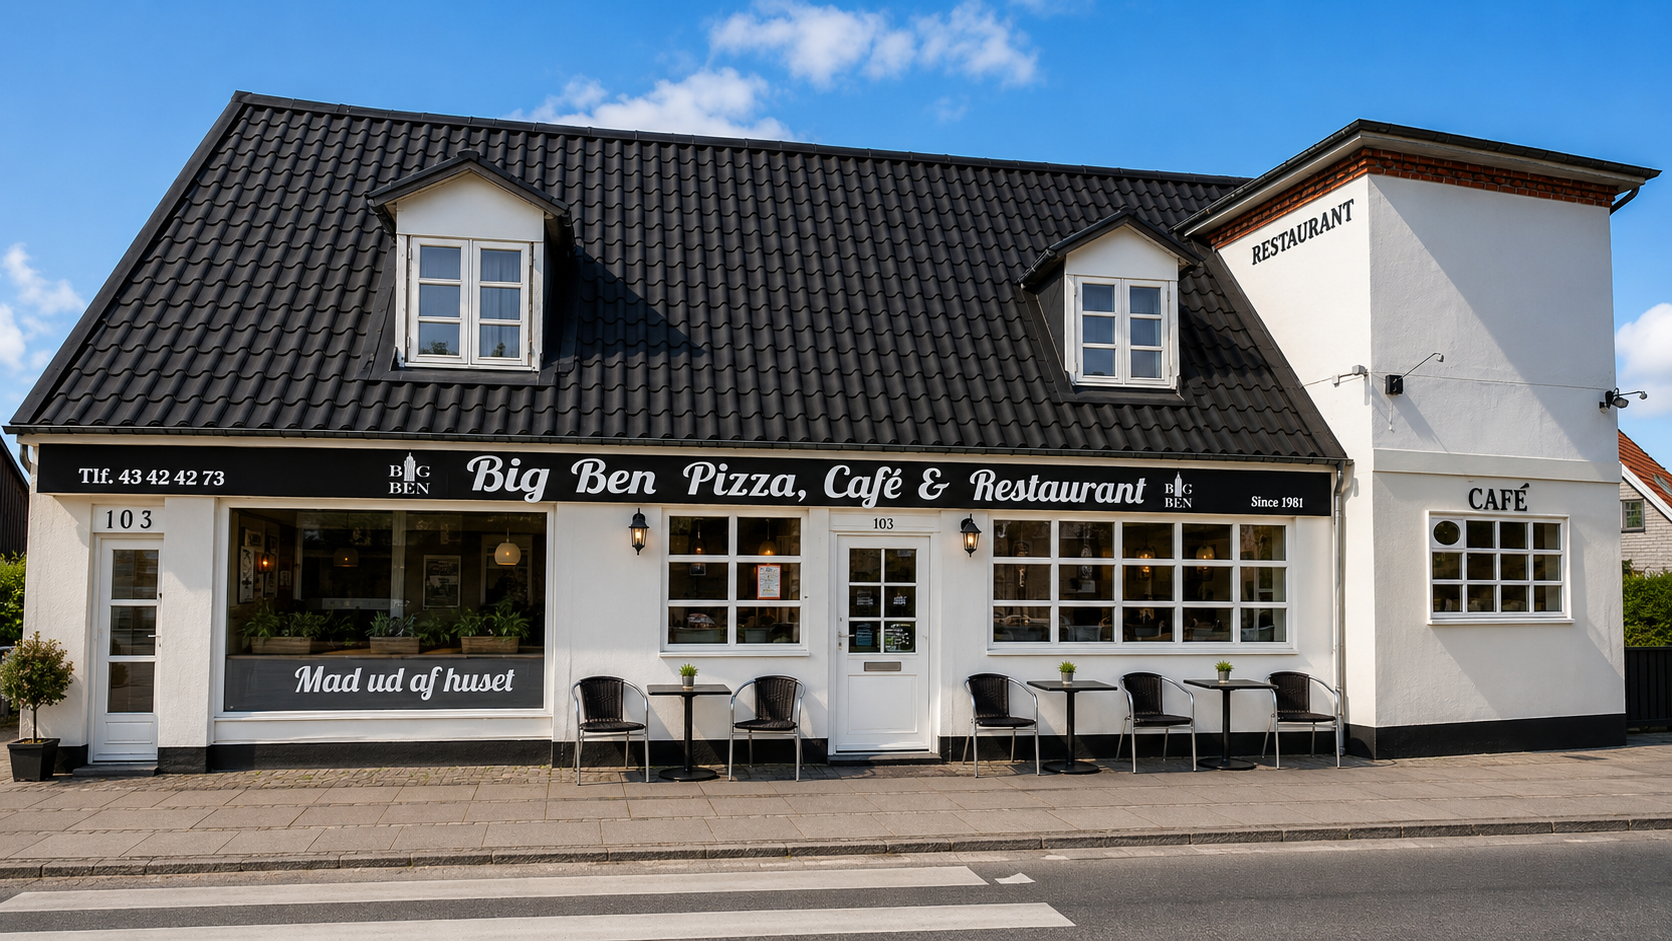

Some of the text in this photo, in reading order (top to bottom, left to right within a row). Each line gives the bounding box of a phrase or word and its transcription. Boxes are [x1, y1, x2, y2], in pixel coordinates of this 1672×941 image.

[1252, 199, 1354, 266] RESTAURANT
[78, 467, 225, 487] Tlf. 43 42 42 73
[466, 455, 1147, 509] Big Ben Pizza, Café & Restaurant
[389, 482, 430, 495] BEN
[1468, 482, 1530, 512] CAFÉ
[1164, 498, 1192, 508] BEN
[1251, 496, 1303, 509] Since 1981
[106, 509, 153, 530] 103
[873, 517, 894, 530] 103
[294, 665, 515, 701] Mad ud af huset
